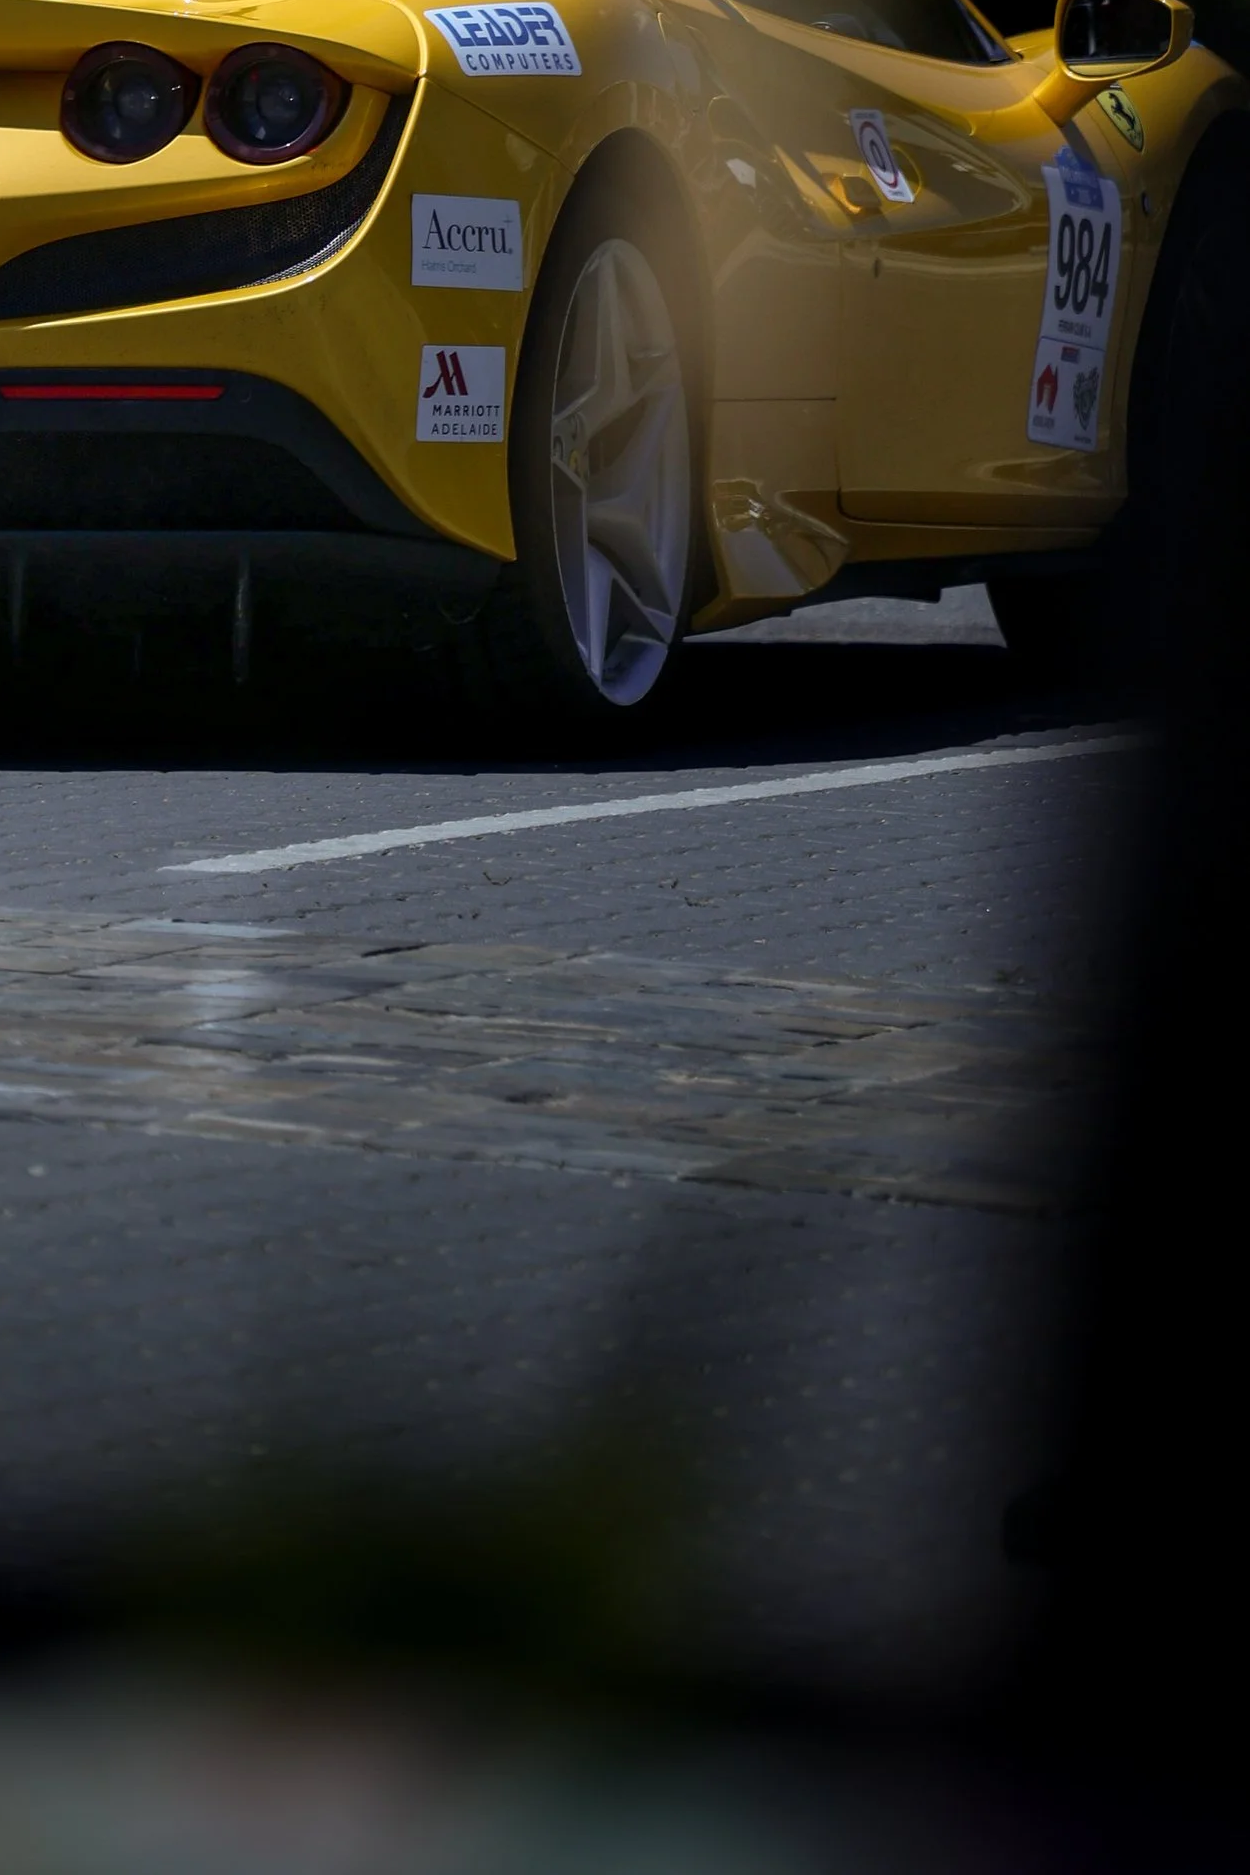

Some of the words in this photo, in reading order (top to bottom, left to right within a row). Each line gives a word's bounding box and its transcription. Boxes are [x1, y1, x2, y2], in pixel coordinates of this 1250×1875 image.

[434, 7, 566, 47] LEADER
[465, 52, 574, 71] COMPUTERS
[421, 208, 508, 254] Accru
[1053, 213, 1112, 318] 984
[432, 404, 501, 417] MARRIOTT
[431, 423, 498, 436] ADELAIDE
